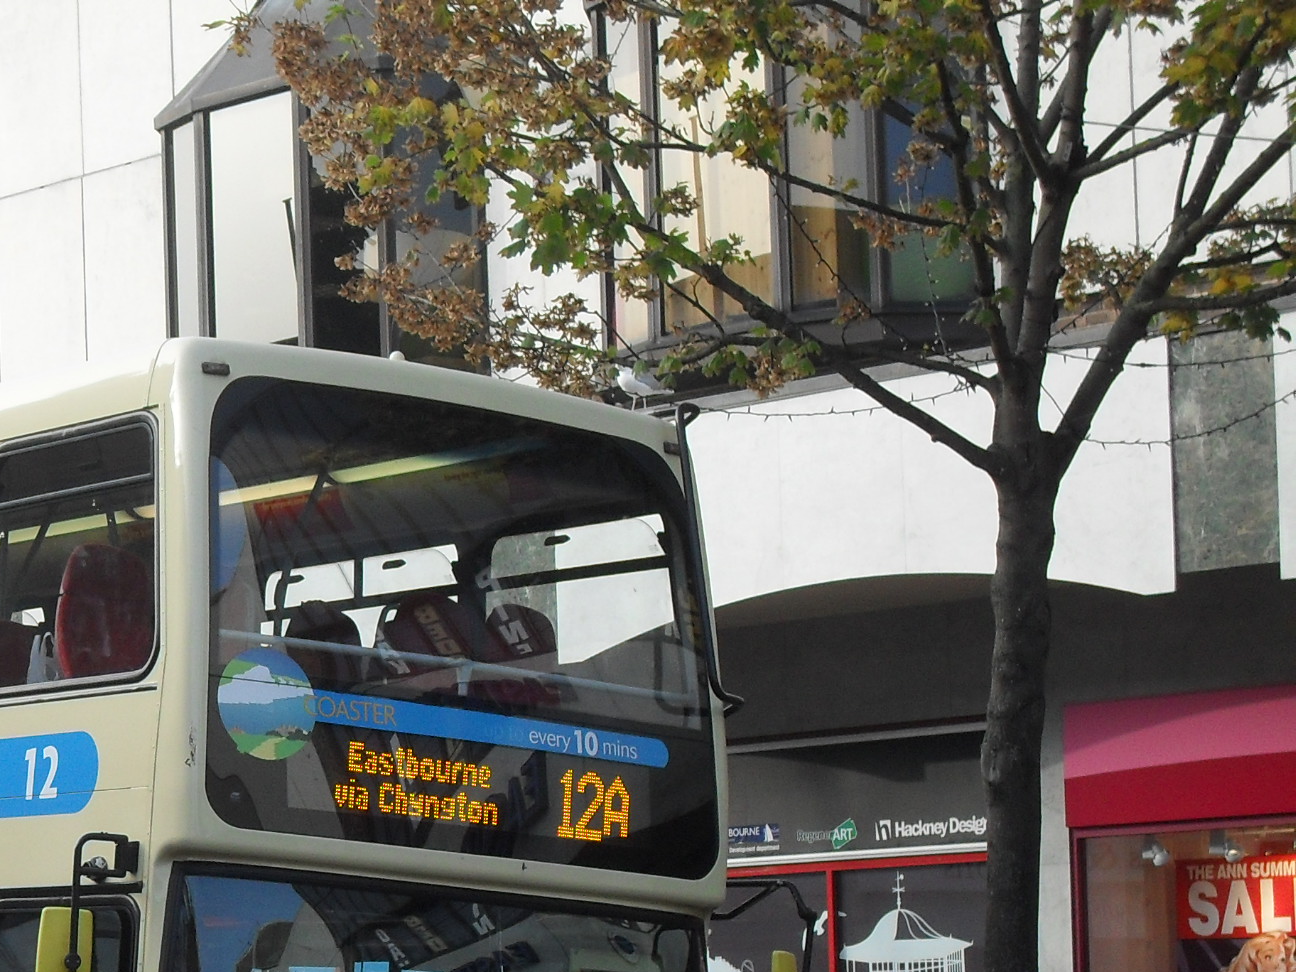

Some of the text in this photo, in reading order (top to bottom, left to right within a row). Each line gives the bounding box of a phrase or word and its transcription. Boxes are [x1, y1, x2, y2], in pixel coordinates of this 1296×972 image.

[304, 695, 397, 726] COASTER
[348, 741, 491, 789] Eastbourne
[529, 730, 572, 751] every
[573, 729, 599, 756] 10
[602, 740, 639, 761] mins
[24, 745, 59, 800] 12
[334, 778, 498, 826] via Chyngton
[557, 769, 631, 842] 12A
[895, 819, 947, 838] Hackney
[1186, 865, 1214, 880] THE
[1217, 863, 1247, 879] ANN
[1188, 877, 1296, 937] SAL
